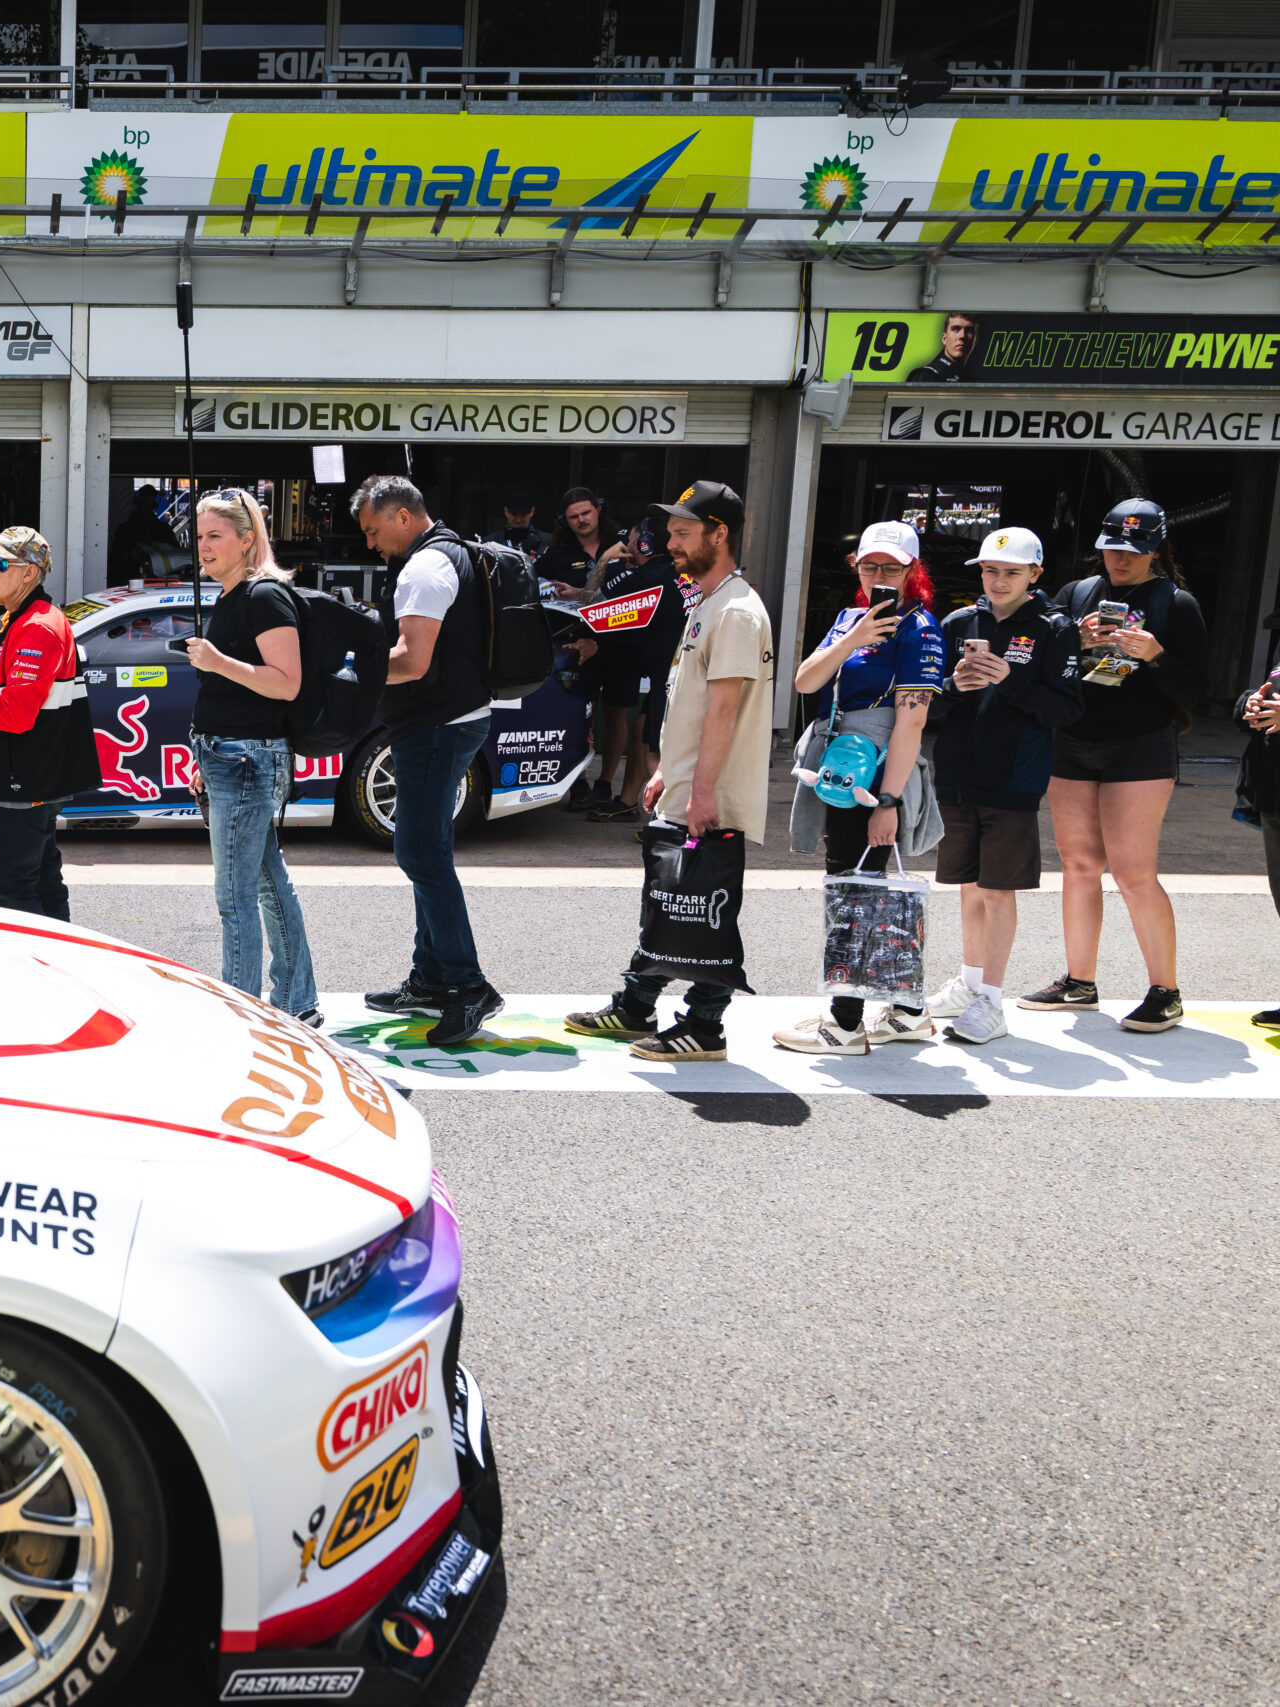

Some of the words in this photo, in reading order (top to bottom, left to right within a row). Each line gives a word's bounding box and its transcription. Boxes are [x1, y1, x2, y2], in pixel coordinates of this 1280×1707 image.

[123, 125, 151, 150] bp
[846, 130, 875, 154] bp
[252, 147, 561, 207] ultimate
[970, 153, 1280, 213] ultimate
[6, 341, 52, 361] GF
[850, 321, 911, 372] 19
[221, 401, 401, 433] GLIDEROL
[409, 403, 549, 434] GARAGE
[558, 405, 676, 436] DOORS
[933, 409, 1113, 440] GLIDEROL
[1122, 411, 1264, 442] GARAGE
[587, 593, 658, 623] SUPERCHEAP
[611, 613, 635, 625] AUTO
[135, 669, 165, 677] ultimate
[506, 729, 567, 744] AMPLIFY
[497, 743, 537, 755] Premium
[538, 741, 564, 753] Fuels
[519, 760, 561, 773] QUAD
[518, 771, 559, 785] LOCK
[661, 901, 707, 915] CIRCUIT
[676, 894, 707, 906] PARK
[669, 914, 707, 923] MELBOURNE
[28, 1381, 78, 1423] PRAC
[330, 1355, 423, 1456] CHIKO
[404, 1529, 474, 1621] Tyrepower
[230, 1673, 355, 1694] FASTMASTER
